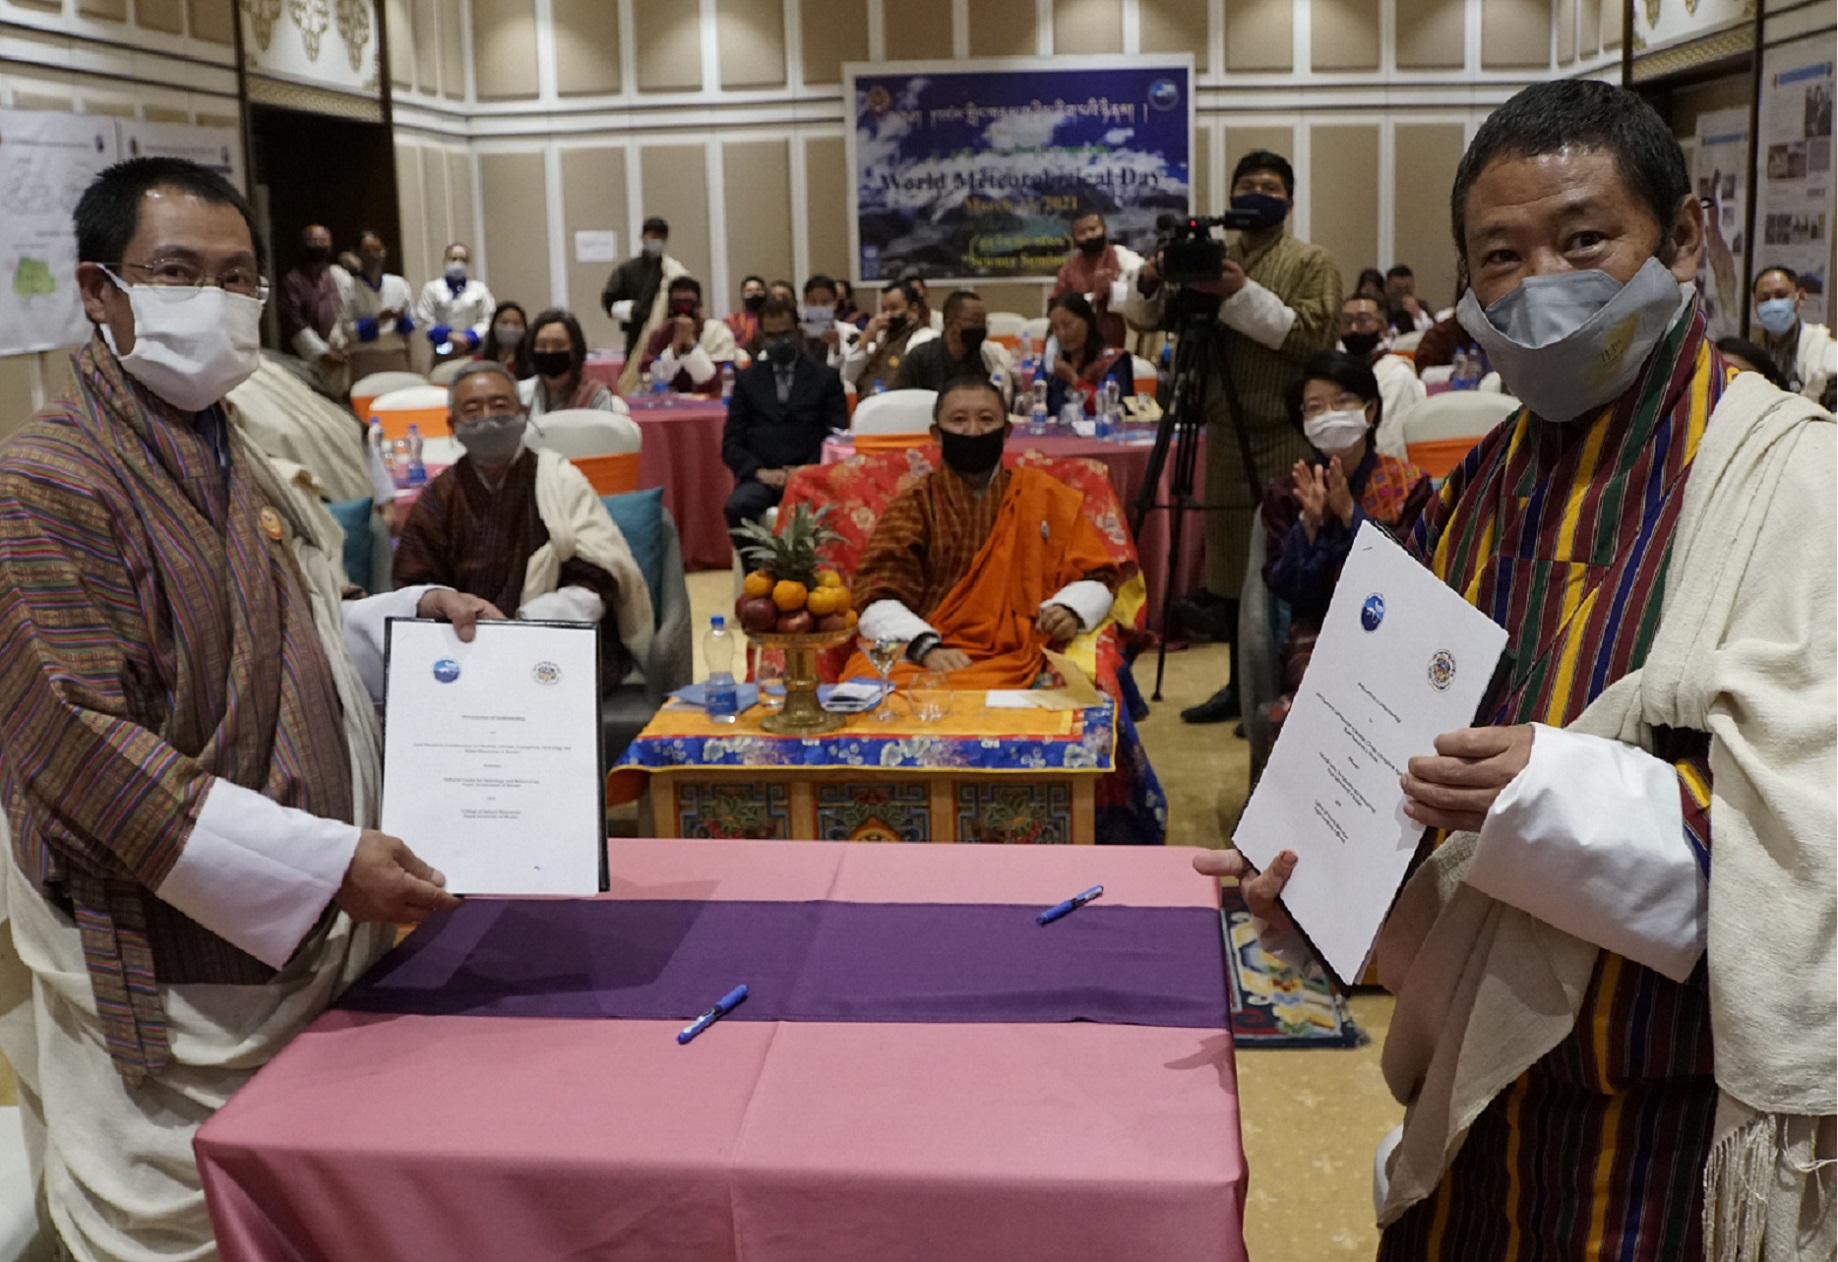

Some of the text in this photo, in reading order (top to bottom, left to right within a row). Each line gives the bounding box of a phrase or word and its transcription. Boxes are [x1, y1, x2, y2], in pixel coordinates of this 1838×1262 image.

[880, 169, 946, 191] World
[1120, 166, 1159, 190] Day
[1044, 196, 1078, 210] 2021
